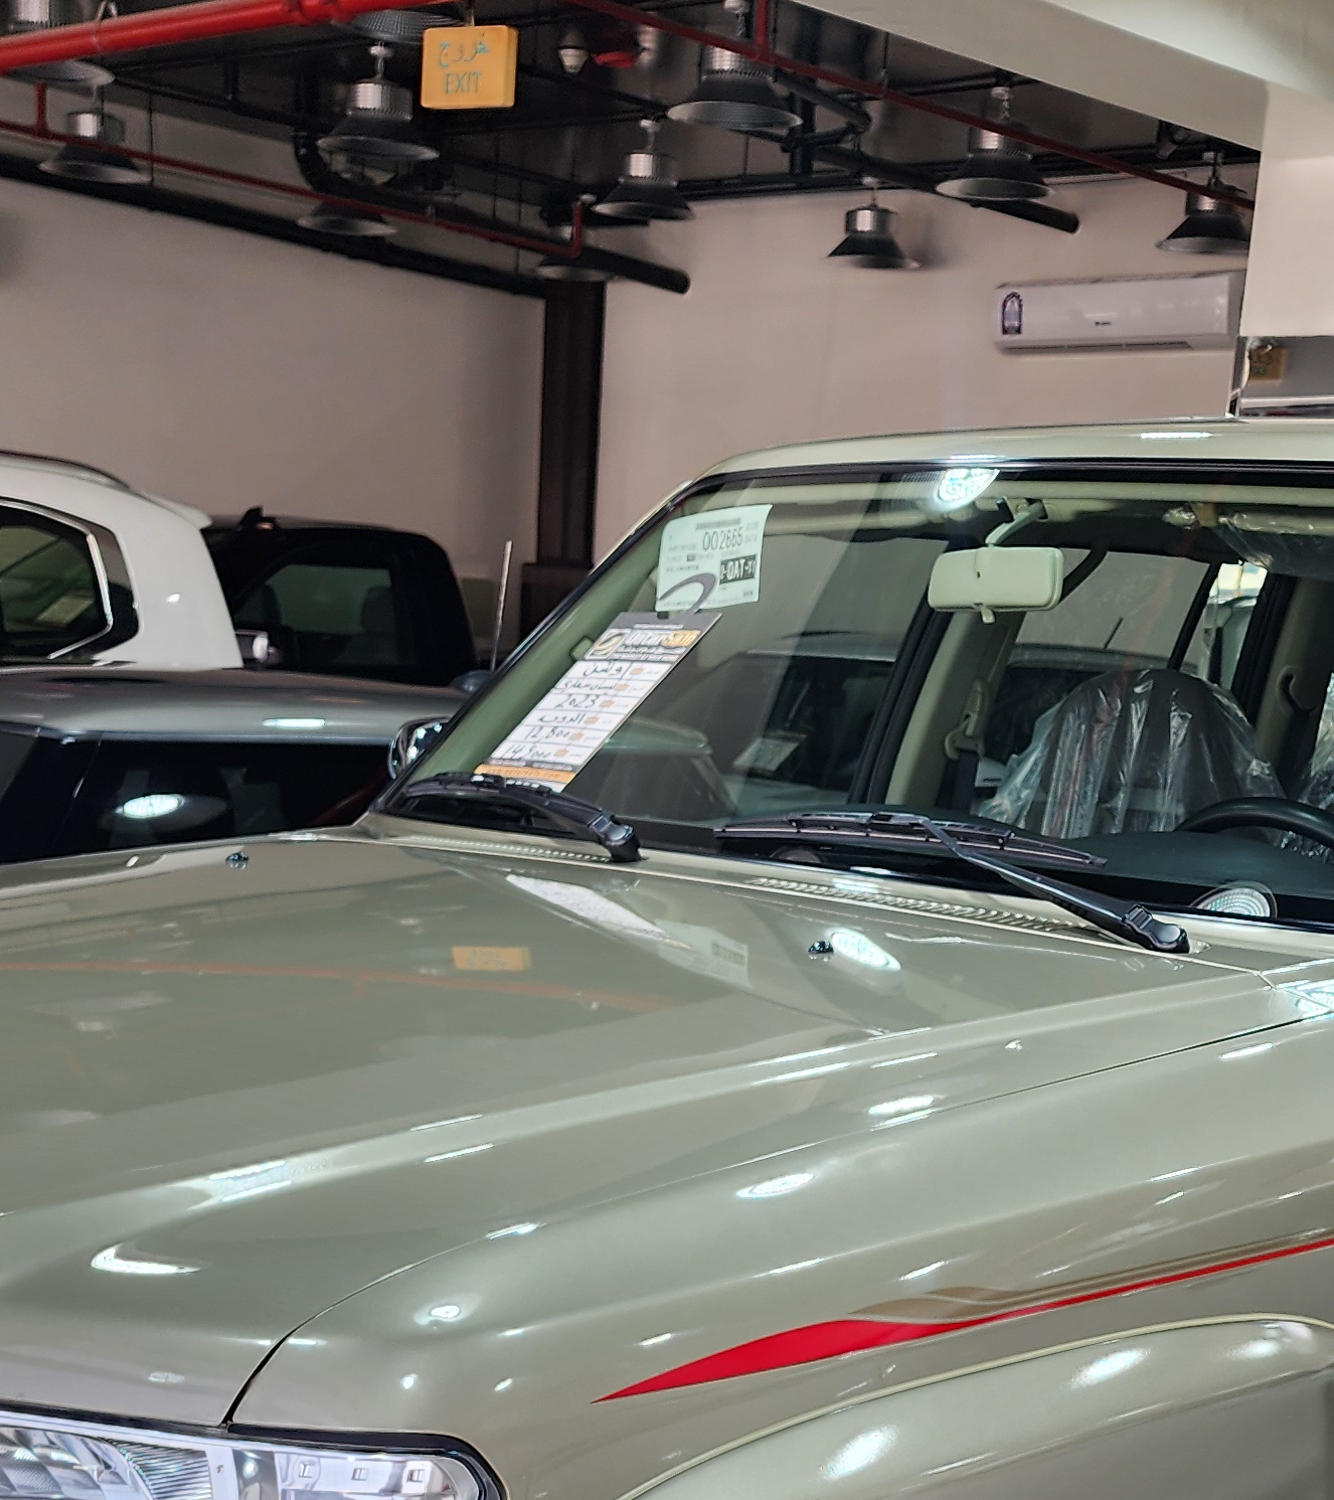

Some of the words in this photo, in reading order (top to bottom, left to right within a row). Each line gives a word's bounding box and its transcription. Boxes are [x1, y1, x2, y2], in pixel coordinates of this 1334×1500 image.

[438, 32, 489, 67] خروج
[444, 71, 482, 94] EXIT
[554, 693, 601, 708] 2023
